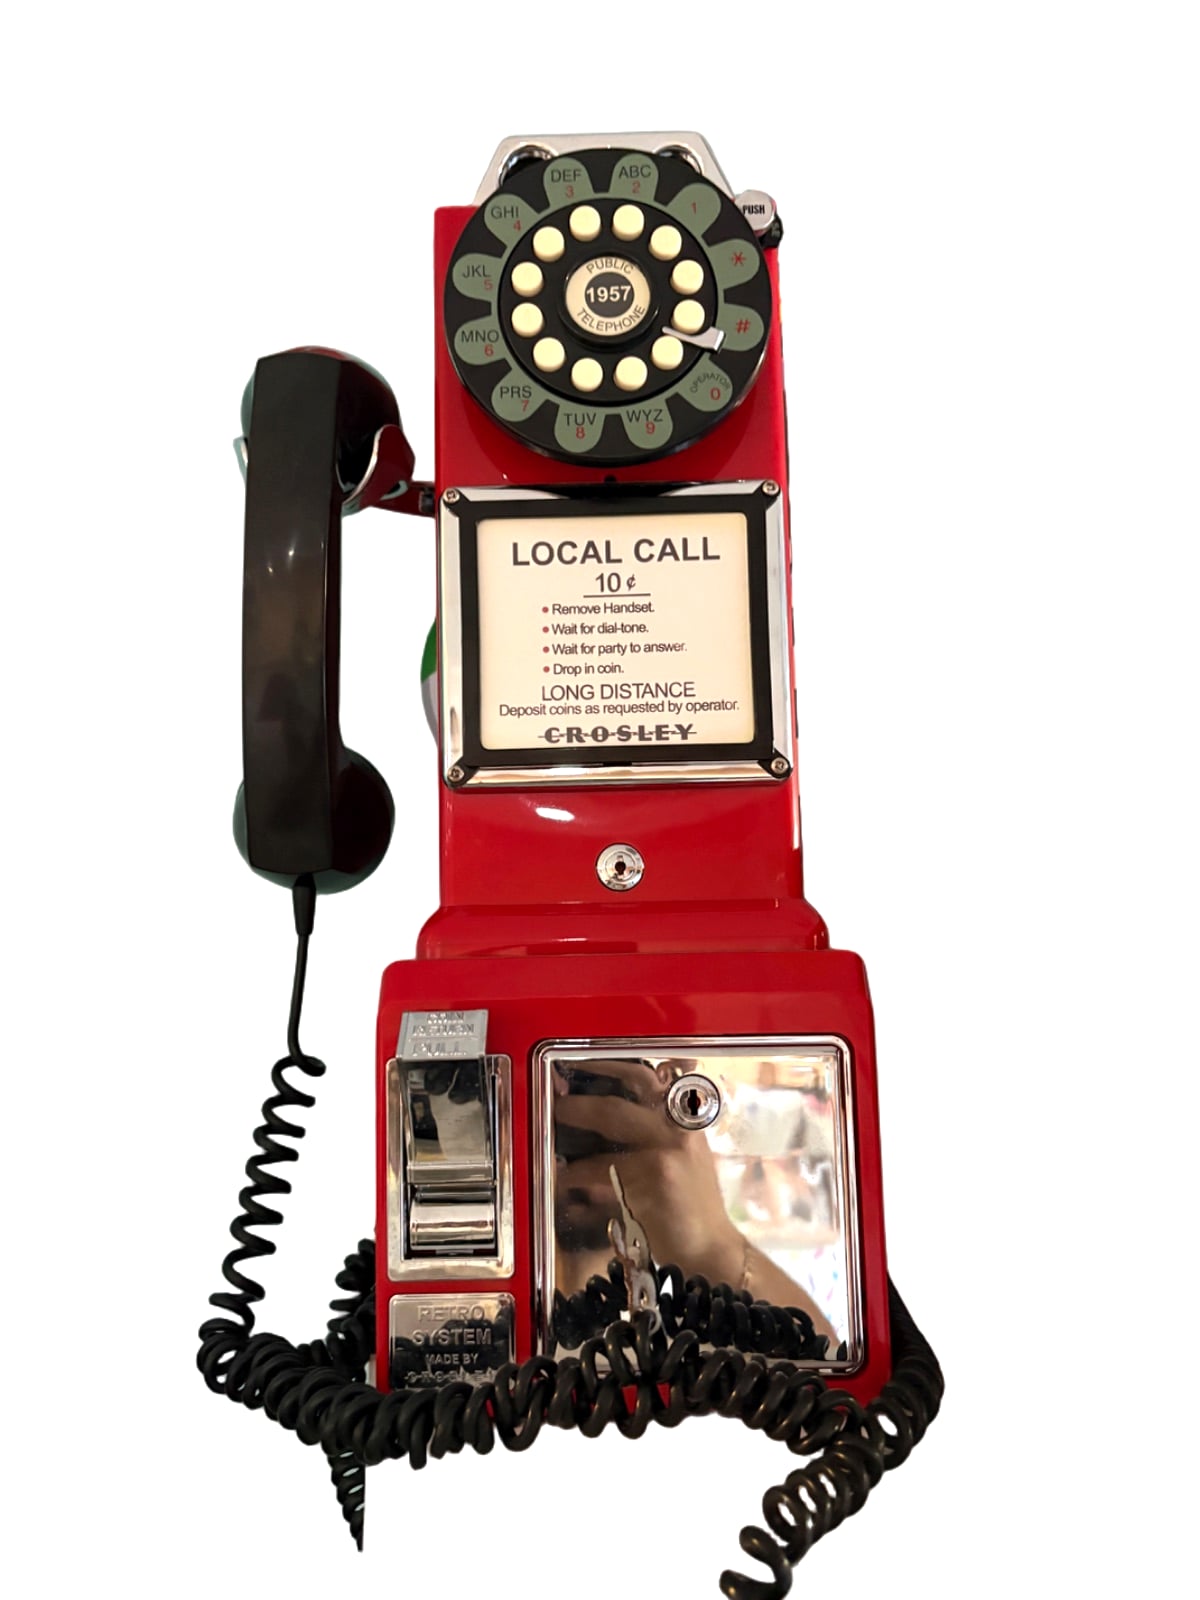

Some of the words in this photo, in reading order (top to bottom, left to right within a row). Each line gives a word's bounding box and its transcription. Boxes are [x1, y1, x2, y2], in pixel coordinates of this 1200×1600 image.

[551, 168, 583, 183] DEF
[618, 165, 652, 179] ABC
[565, 185, 575, 199] 3
[632, 181, 641, 194] 2
[490, 205, 520, 219] GHI
[690, 202, 698, 214] 1
[742, 204, 766, 216] PUSH
[513, 219, 522, 231] 4
[462, 264, 492, 279] JKL
[585, 257, 634, 274] PUBLIC
[483, 279, 493, 291] 5
[586, 285, 632, 303] 1957
[577, 304, 646, 332] TELEPHONE
[460, 329, 500, 344] MNO
[484, 344, 495, 357] 6
[689, 372, 731, 394] OPERATOR
[500, 385, 533, 399] PRS
[710, 387, 721, 401] 0
[521, 399, 530, 412] 7
[563, 412, 597, 427] TUV
[626, 408, 664, 423] WYZ
[575, 427, 586, 440] 8
[645, 422, 656, 435] 9
[512, 540, 623, 566] LOCAL
[633, 537, 721, 562] CALL
[595, 572, 621, 593] 10
[551, 602, 601, 615] Remove
[603, 601, 655, 614] Handset.
[551, 622, 578, 635] Wait
[580, 622, 596, 635] for
[597, 621, 649, 634] dial-tone.
[551, 642, 578, 655] Wait
[580, 642, 597, 655] for
[597, 643, 627, 656] party
[630, 642, 642, 653] to
[643, 642, 688, 653] answer.
[553, 663, 582, 677] Drop
[584, 662, 595, 675] in
[597, 662, 624, 675] coin.
[541, 684, 595, 701] LONG
[600, 681, 696, 700] DISTANCE
[499, 704, 547, 718] Deposit
[549, 703, 582, 715] coins
[584, 705, 600, 715] as
[603, 701, 665, 716] requested
[668, 701, 682, 715] by
[685, 699, 740, 714] operator.
[541, 723, 695, 744] CROSLEY
[417, 1304, 485, 1321] RETRO
[412, 1327, 492, 1345] SYSTEM
[425, 1353, 460, 1365] MADE
[462, 1353, 479, 1365] BY
